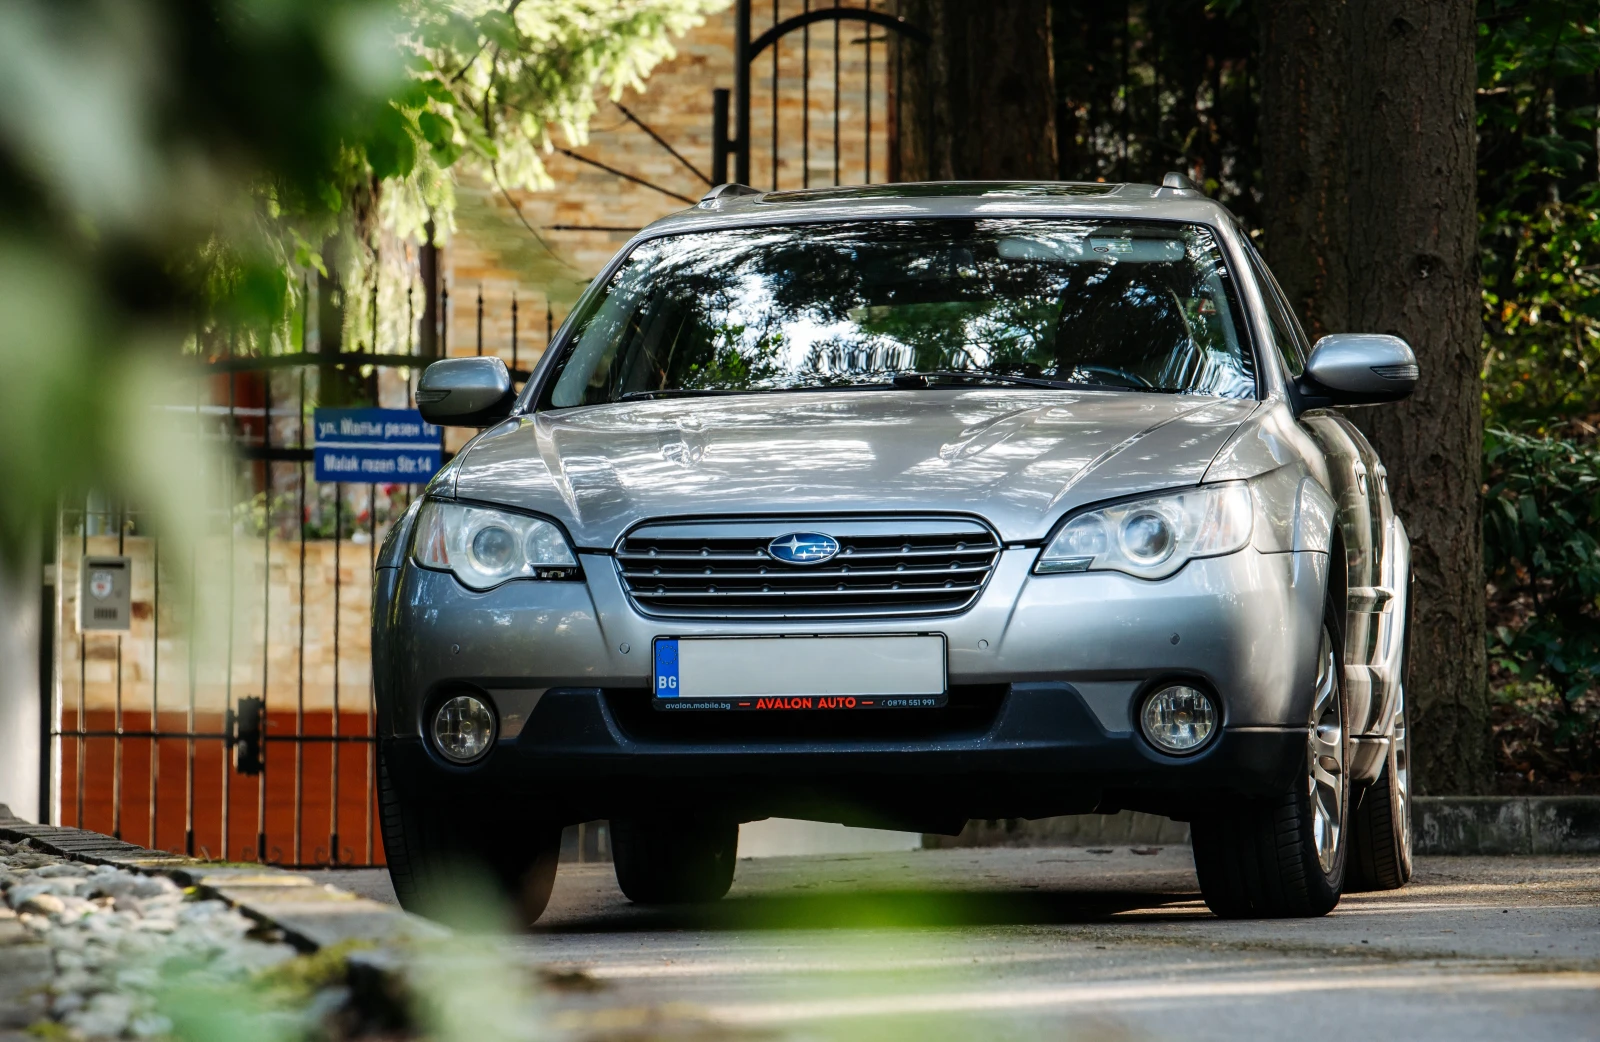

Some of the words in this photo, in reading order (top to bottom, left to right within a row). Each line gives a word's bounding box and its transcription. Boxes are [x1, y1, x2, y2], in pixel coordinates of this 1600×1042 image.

[319, 421, 337, 439] ул.
[323, 454, 359, 472] Malak
[361, 458, 396, 473] rezen
[658, 675, 677, 689] BG
[665, 702, 731, 710] avalon.mobile.bg
[756, 697, 812, 709] AVALON
[817, 697, 857, 709] AUTO
[887, 699, 907, 707] 0878
[908, 699, 921, 707] 551
[922, 699, 935, 707] 991
